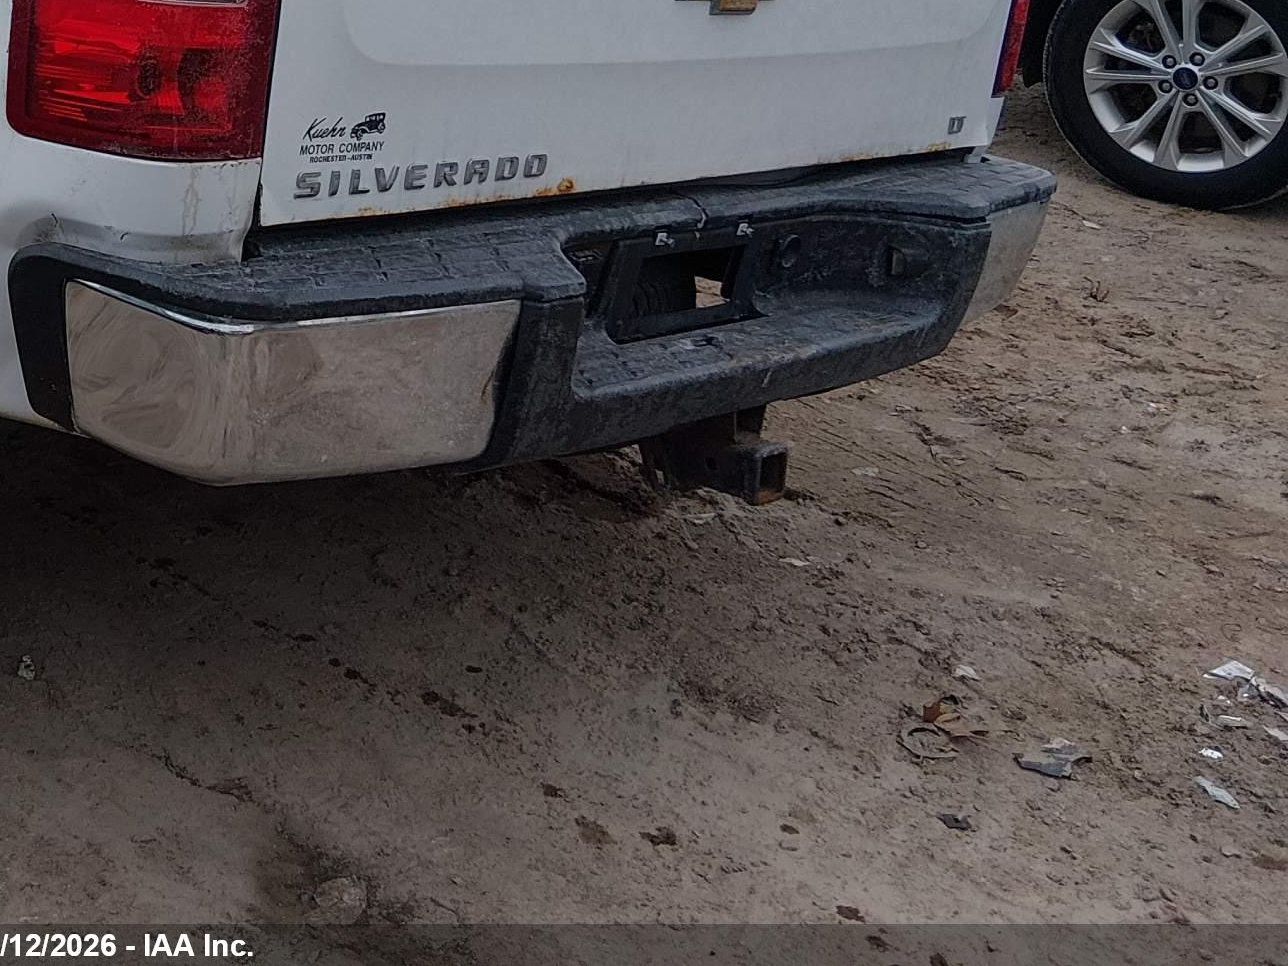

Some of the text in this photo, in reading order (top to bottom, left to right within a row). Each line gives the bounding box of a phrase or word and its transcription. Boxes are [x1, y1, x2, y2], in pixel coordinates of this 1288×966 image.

[302, 116, 347, 141] Kuehn
[299, 140, 385, 156] MOTOR COMPANY
[293, 153, 548, 200] SILVERADO
